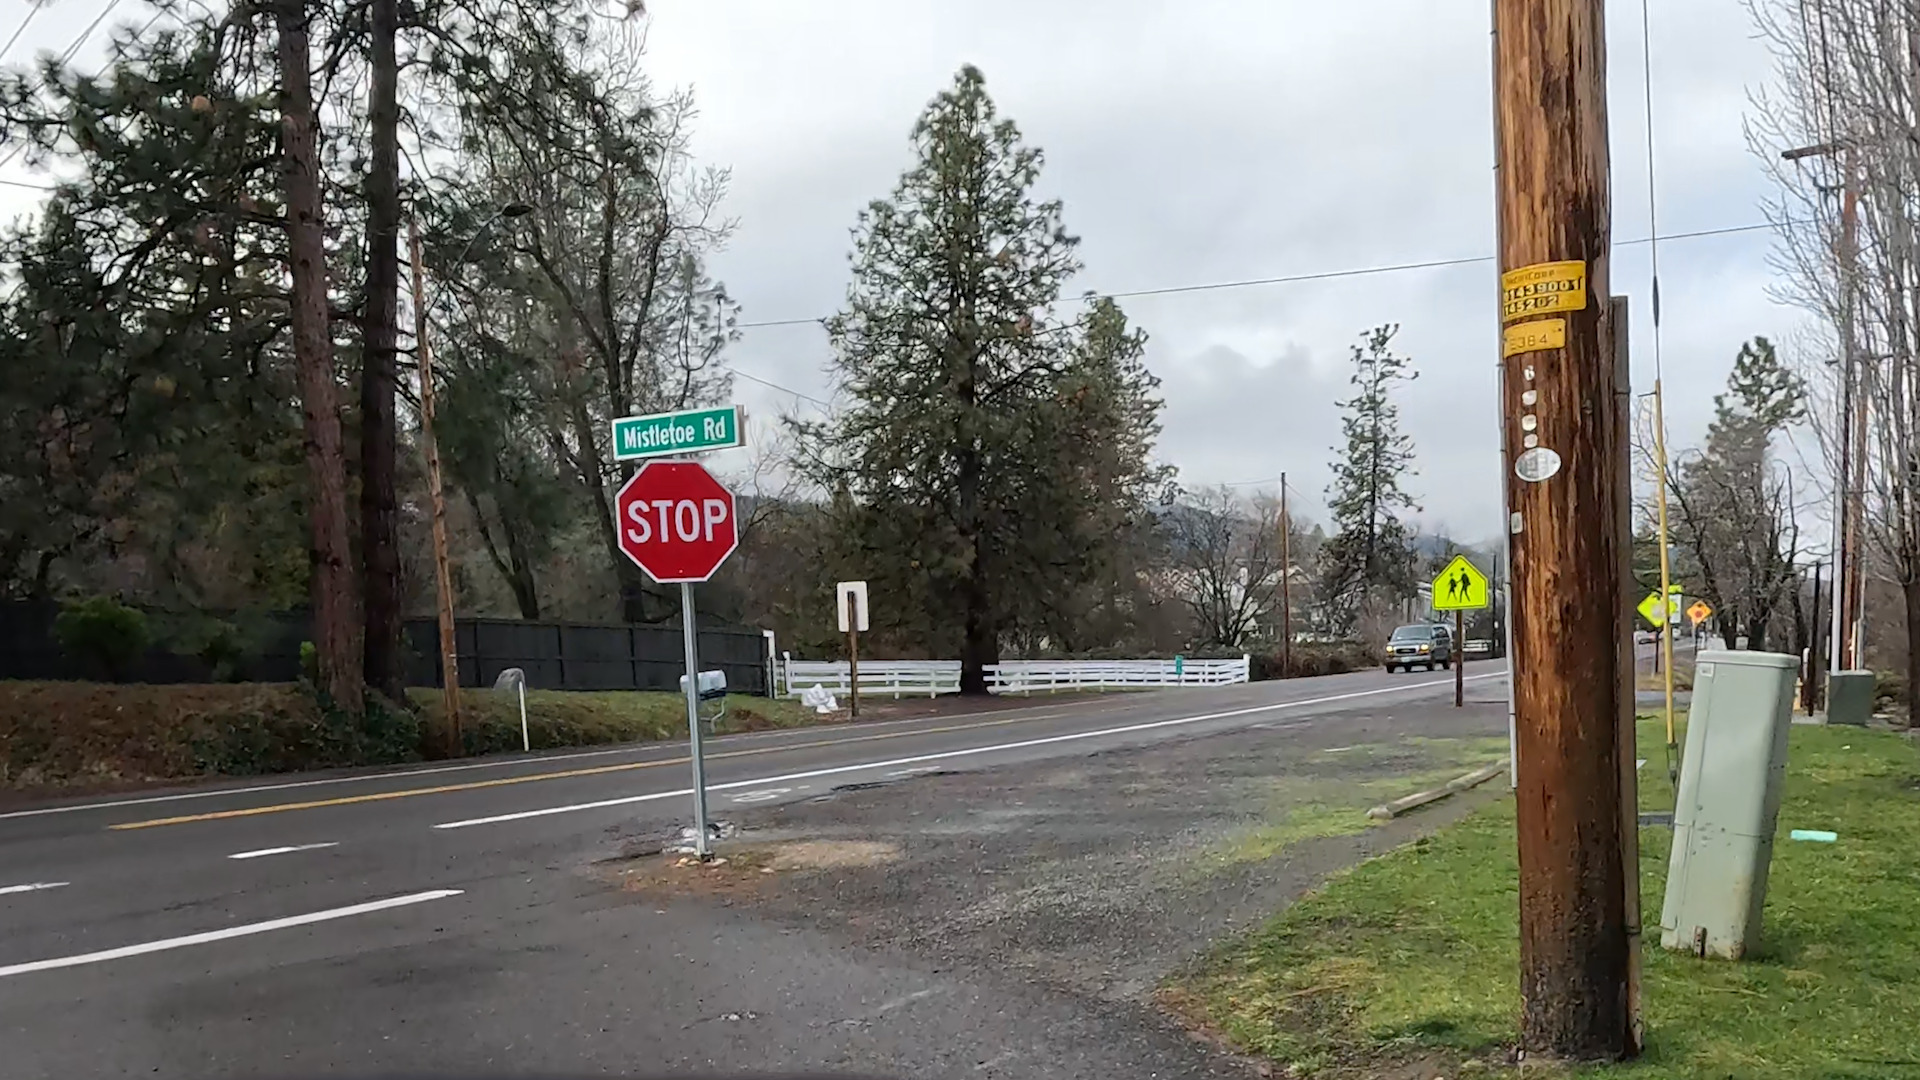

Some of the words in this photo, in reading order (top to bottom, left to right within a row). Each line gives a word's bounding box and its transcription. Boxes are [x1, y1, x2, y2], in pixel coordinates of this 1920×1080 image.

[623, 422, 695, 449] Mistletoe
[703, 416, 726, 440] Rd
[627, 498, 728, 544] STOP
